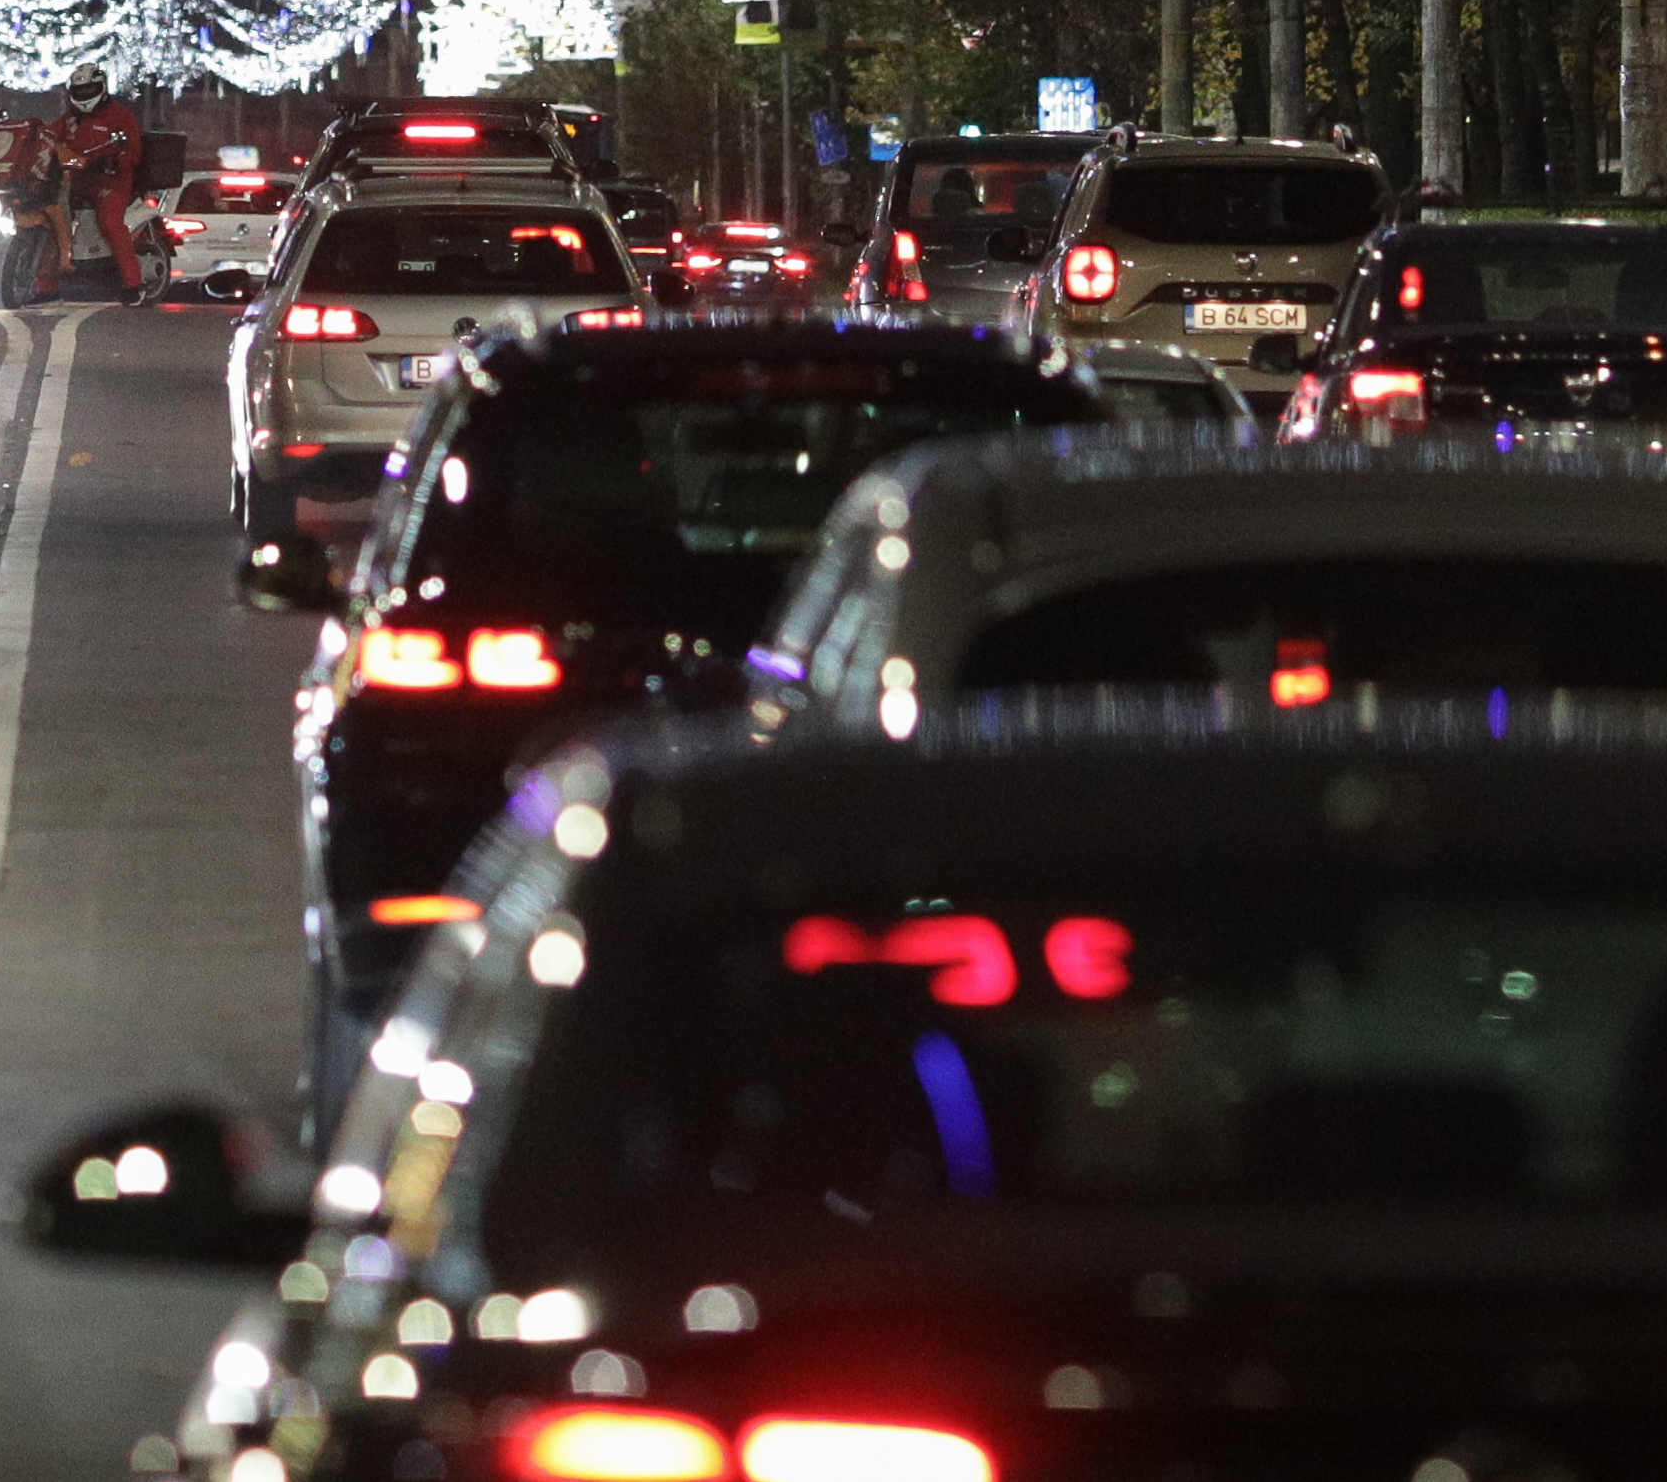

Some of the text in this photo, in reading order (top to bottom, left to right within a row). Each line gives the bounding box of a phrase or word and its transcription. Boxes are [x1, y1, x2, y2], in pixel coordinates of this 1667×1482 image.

[1201, 306, 1299, 326] B 64 SCM
[417, 359, 432, 379] B
